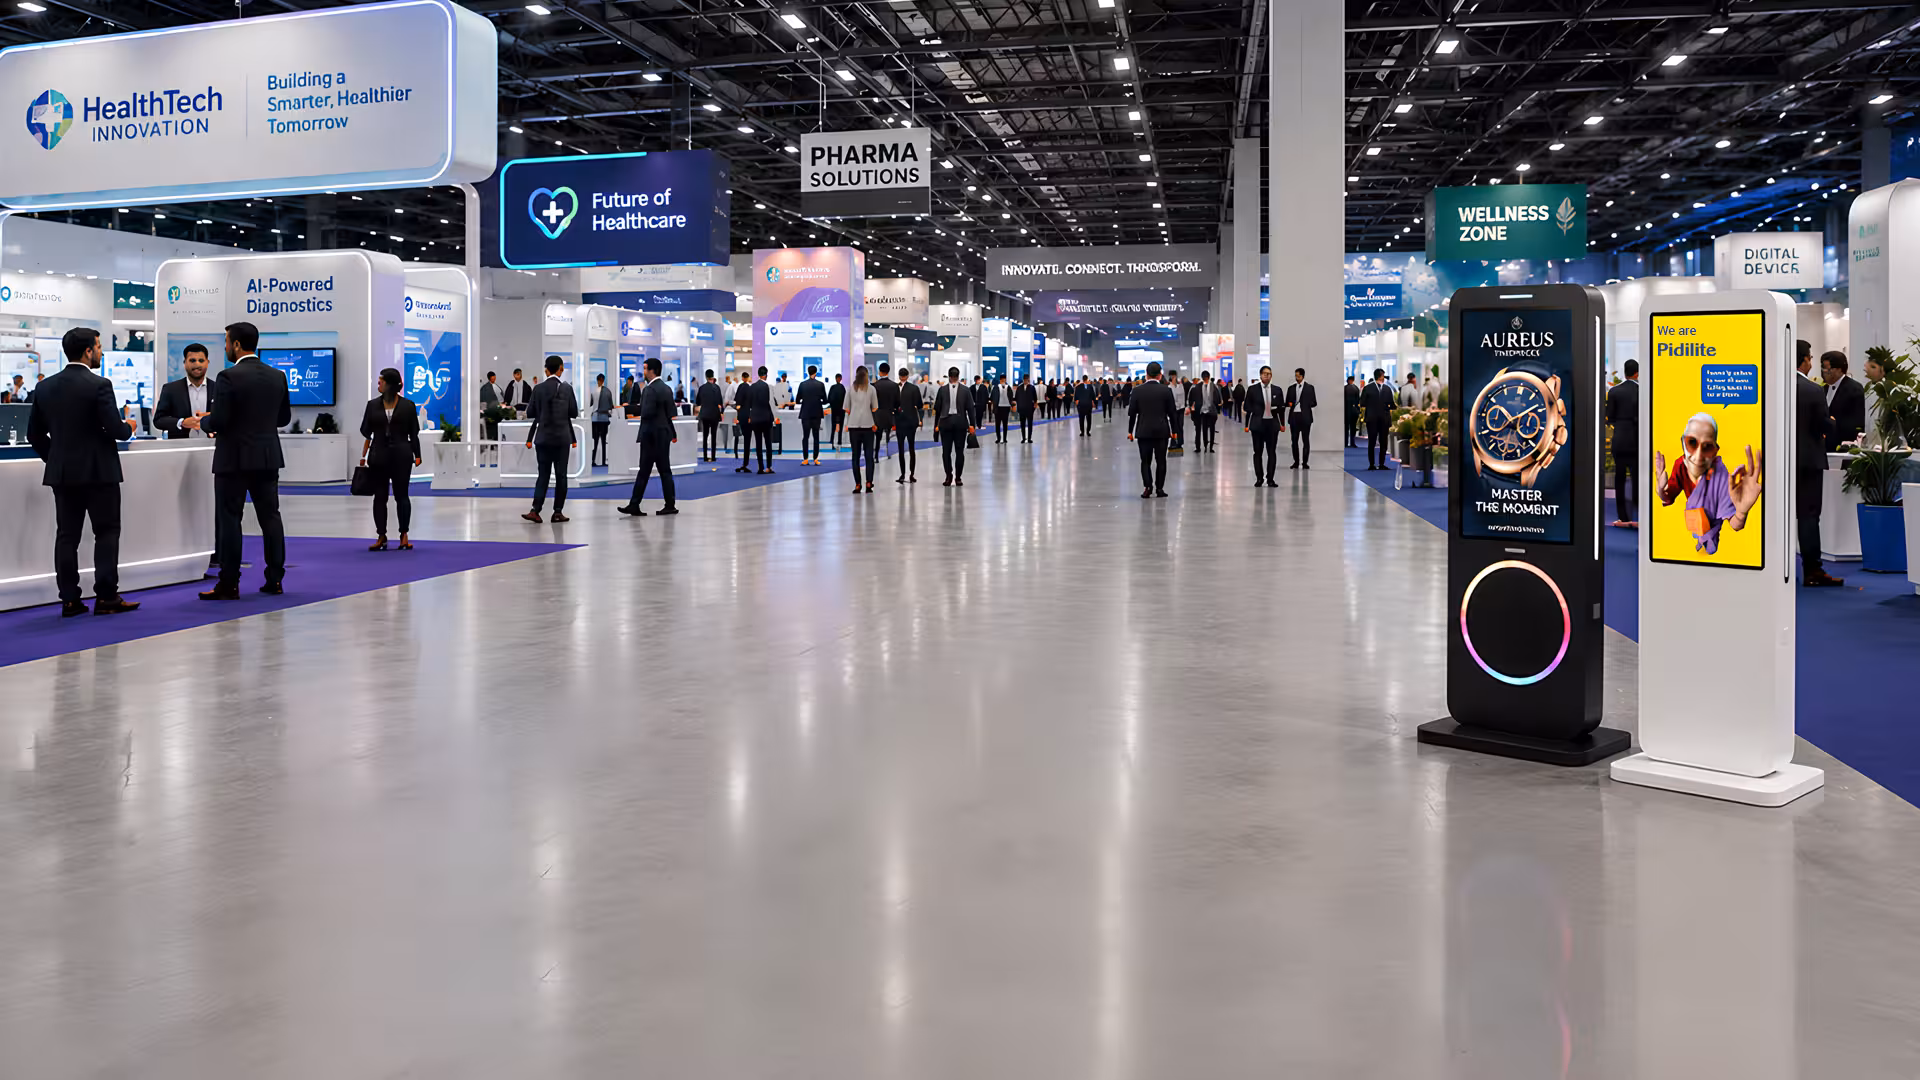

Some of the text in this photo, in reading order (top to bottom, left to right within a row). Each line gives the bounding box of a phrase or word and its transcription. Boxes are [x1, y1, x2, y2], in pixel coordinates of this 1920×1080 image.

[267, 71, 346, 90] Building a
[83, 86, 223, 122] HealthTech
[267, 86, 412, 112] Smarter, Healthier
[92, 118, 209, 142] INNOVATION
[267, 116, 349, 134] Tomorrow
[811, 142, 918, 166] PHARMA
[810, 168, 919, 187] SOLUTIONS
[592, 187, 671, 208] Future of
[592, 212, 686, 231] Healthcare
[1458, 205, 1549, 222] WELLNESS
[1459, 225, 1507, 242] ZONE
[1744, 248, 1800, 260] DIGITAL
[246, 275, 333, 293] AI-Powered
[246, 296, 333, 317] Diagnostics
[1480, 331, 1555, 348] AUREUS
[1657, 325, 1697, 336] We are
[1657, 342, 1717, 357] Pidilite
[1491, 488, 1543, 502] MASTER
[1502, 502, 1560, 516] MOMENT
